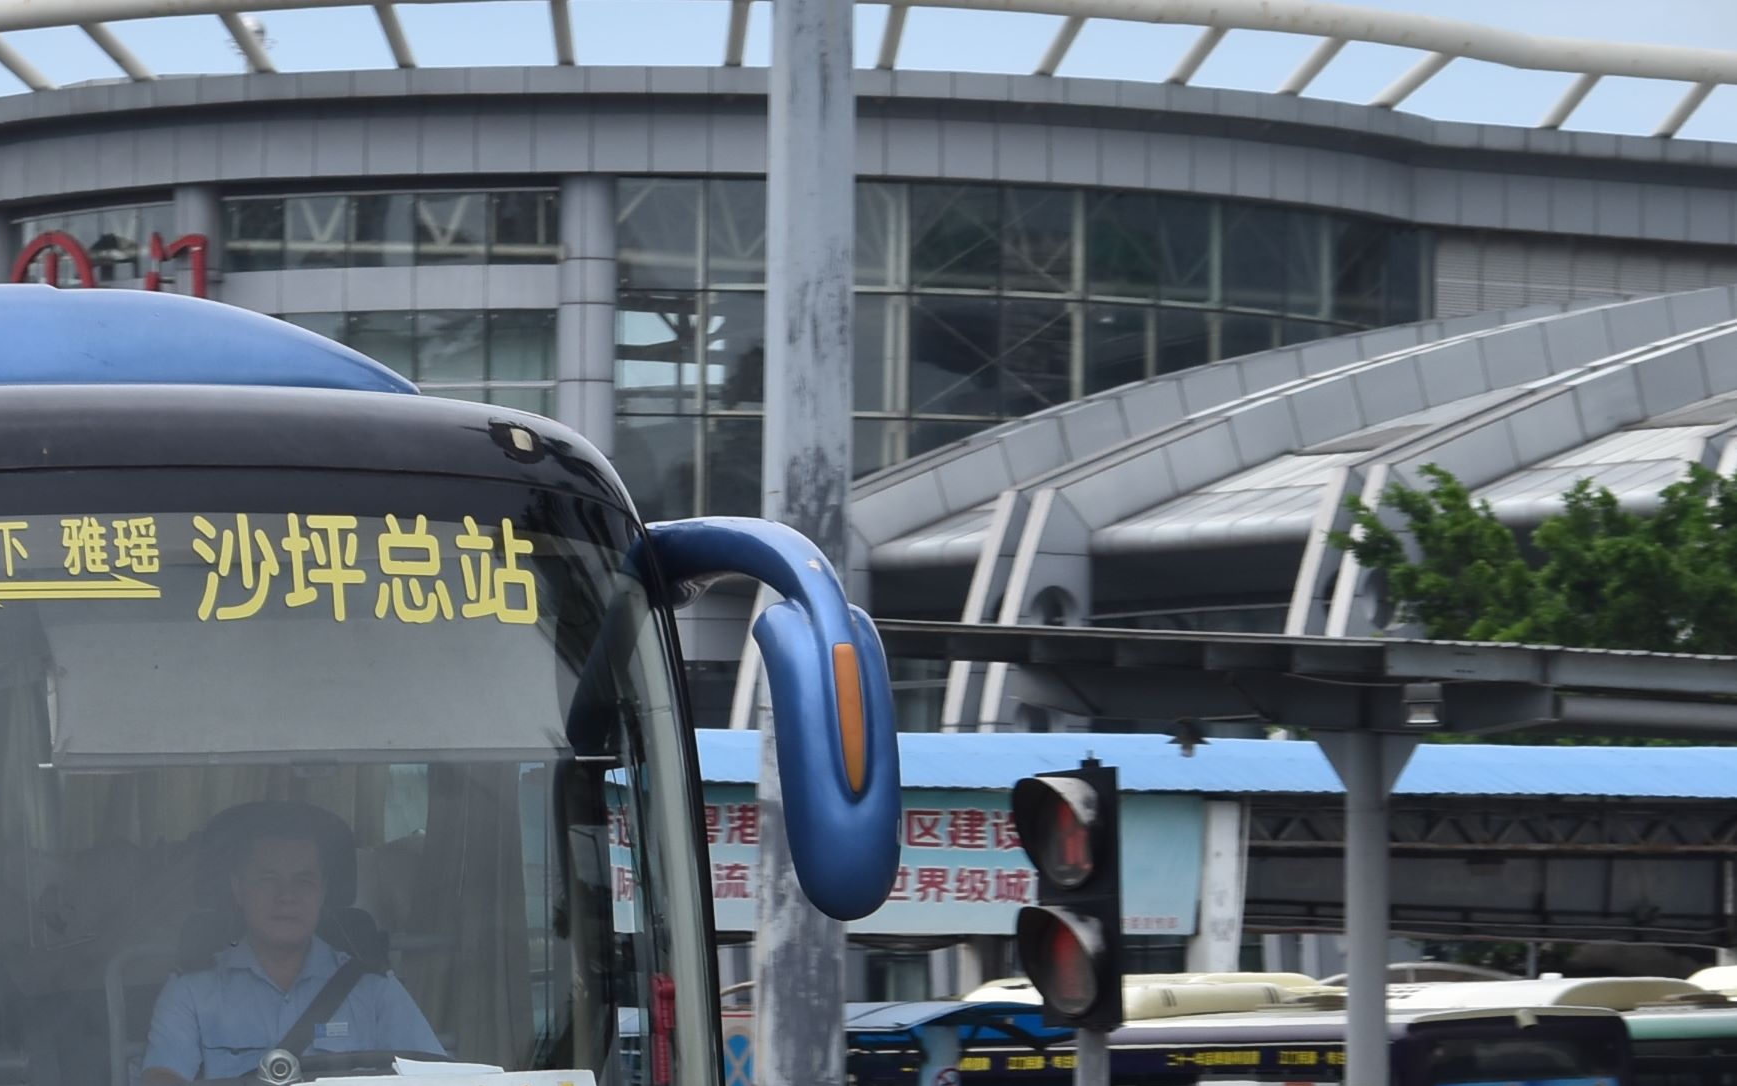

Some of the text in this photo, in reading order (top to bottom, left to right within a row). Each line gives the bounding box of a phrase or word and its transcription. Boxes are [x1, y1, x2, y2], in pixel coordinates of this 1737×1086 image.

[60, 515, 160, 576] 雅瑶
[193, 513, 538, 624] 沙坪总站
